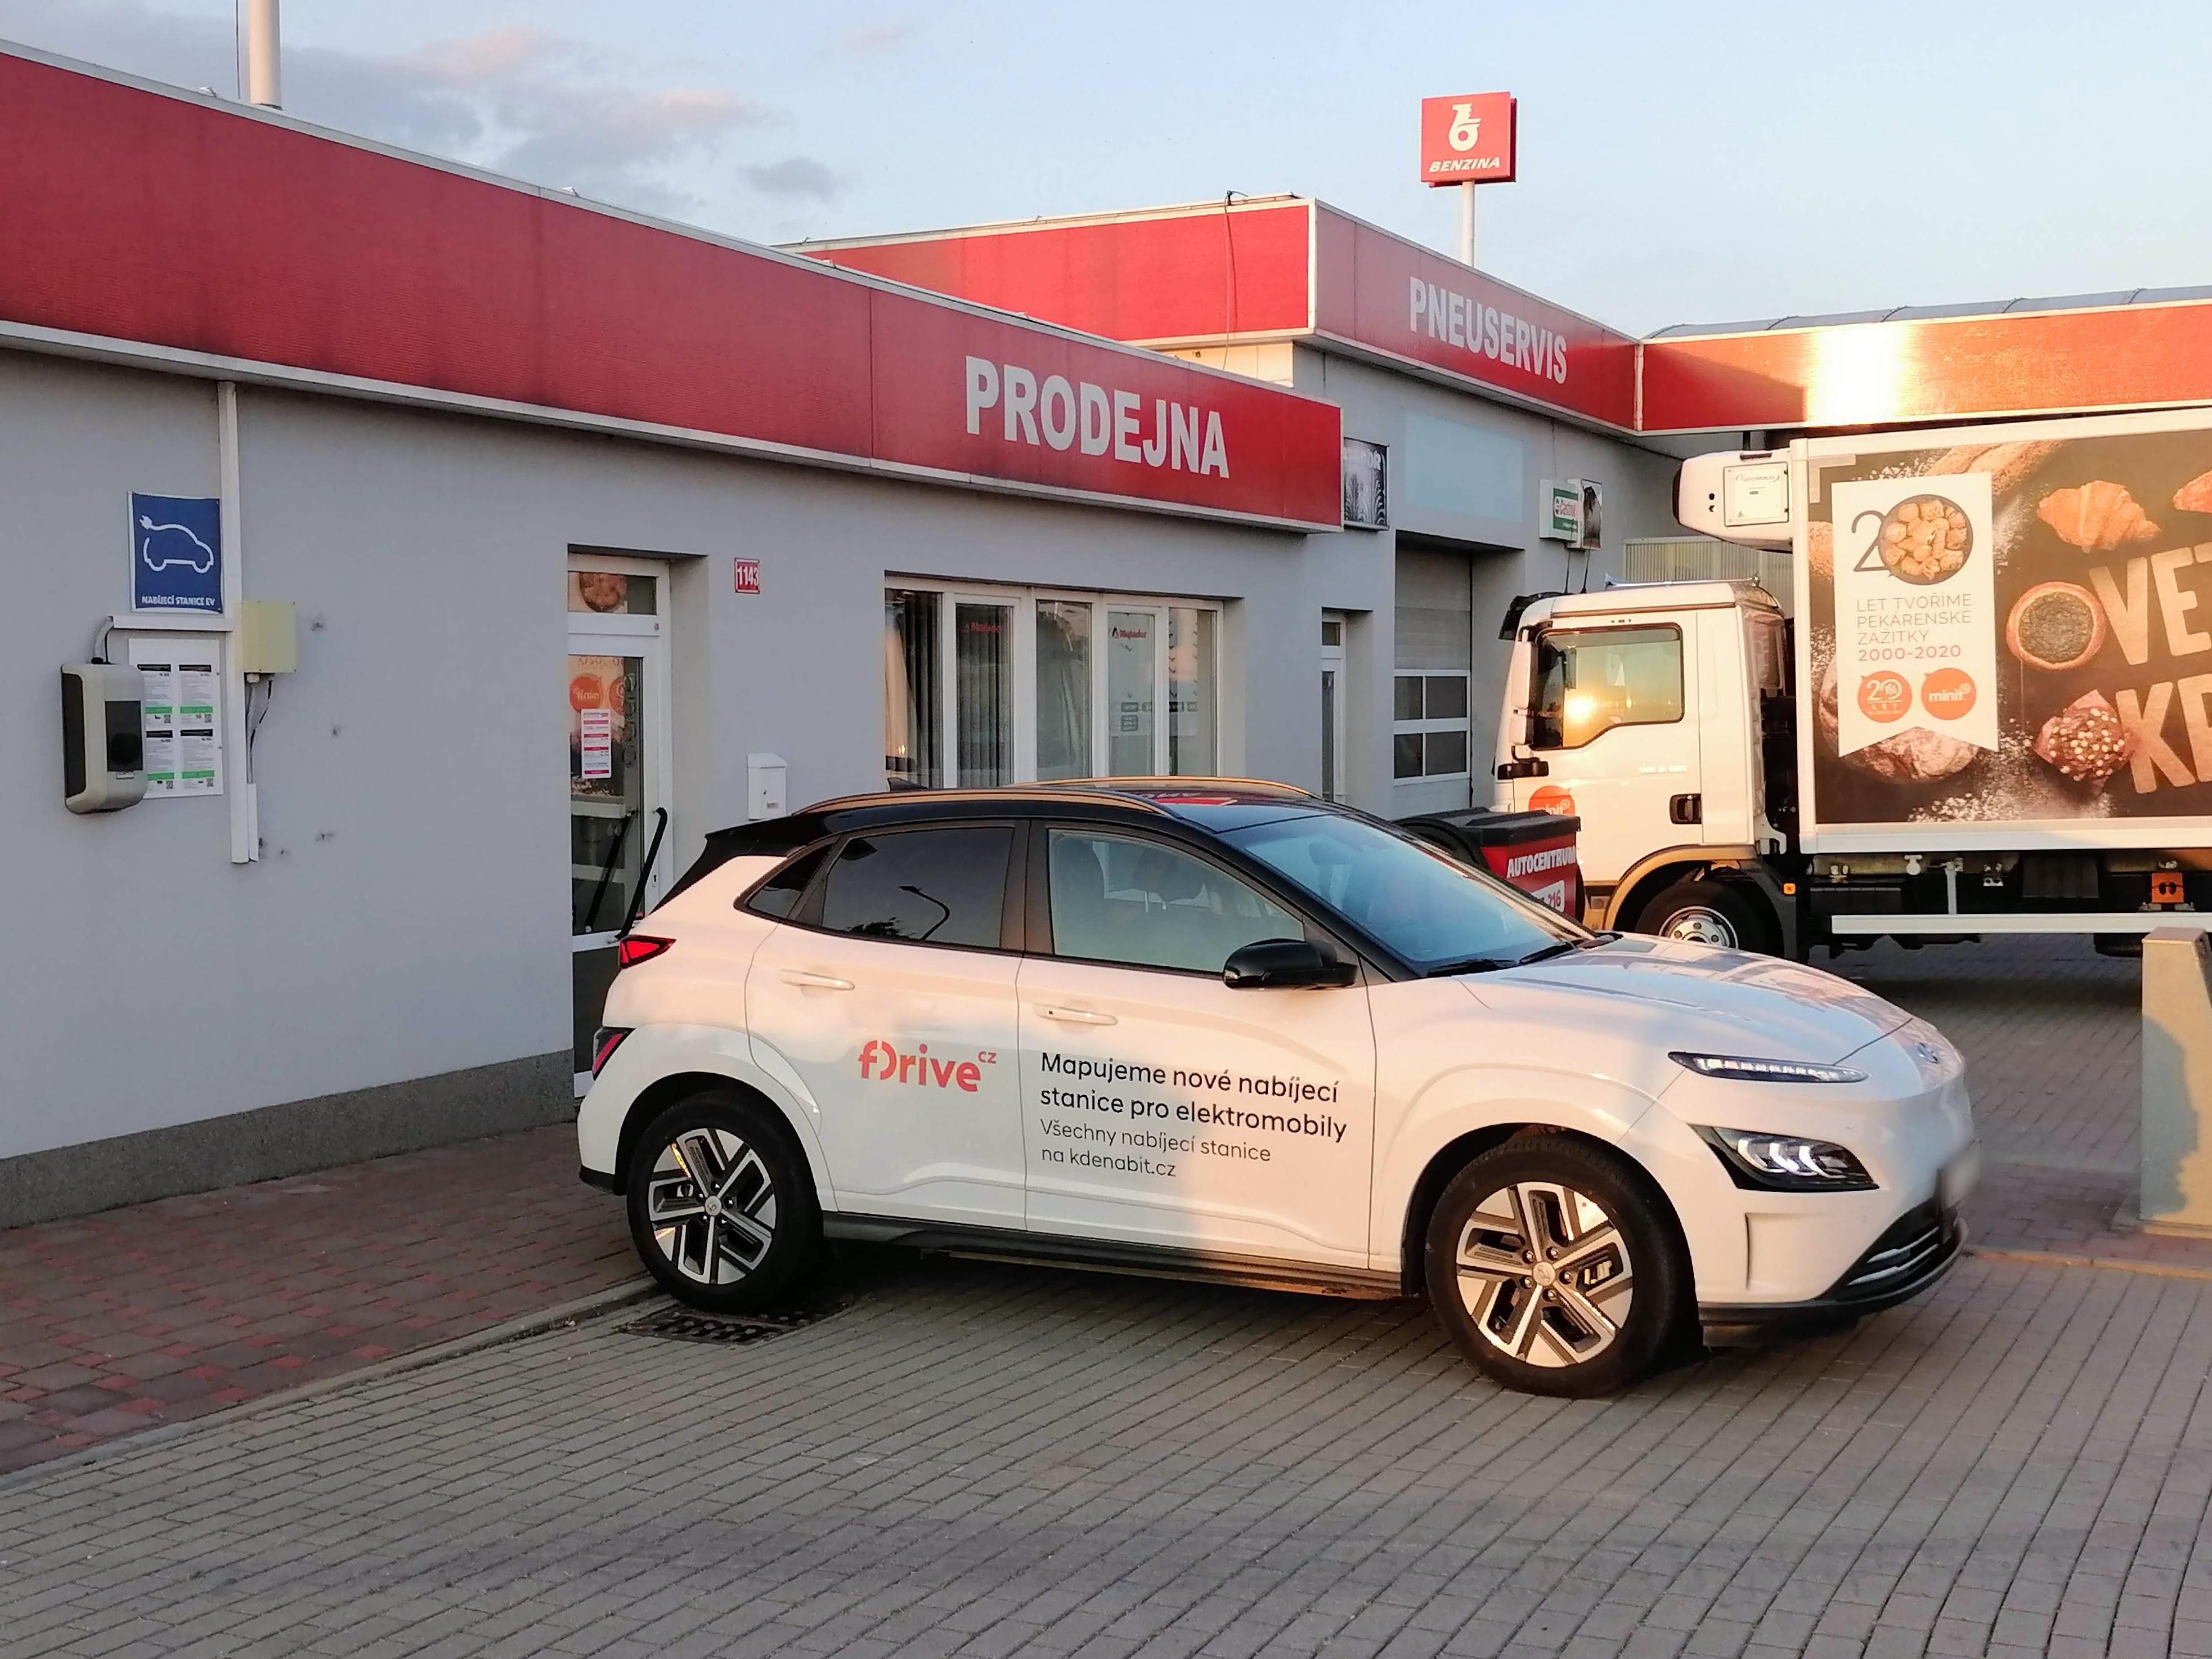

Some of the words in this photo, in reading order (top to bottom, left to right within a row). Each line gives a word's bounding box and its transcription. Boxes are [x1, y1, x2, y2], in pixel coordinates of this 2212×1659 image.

[1429, 156, 1501, 173] BENZINA
[1410, 276, 1567, 384] PNEUSERVIS
[966, 355, 1230, 478] PRODEJNA
[737, 566, 759, 586] 1143
[175, 597, 204, 606] STANICE
[1856, 598, 1887, 612] LET
[1858, 645, 1962, 662] 2000-2020
[1506, 845, 1576, 878] AUTOCENTRUM
[1042, 1052, 1166, 1084] Mapujeme
[1173, 1069, 1231, 1092] nové
[1239, 1075, 1339, 1103] nabíjecí
[1040, 1088, 1124, 1113] stanice
[1131, 1100, 1169, 1119] pro
[1176, 1101, 1347, 1144] elektromobily
[1040, 1118, 1116, 1147] Všechny
[1121, 1131, 1195, 1153] nabíjecí
[1200, 1140, 1271, 1162] stanice
[1042, 1148, 1064, 1163] na
[1070, 1147, 1177, 1177] kdenabit.cz
